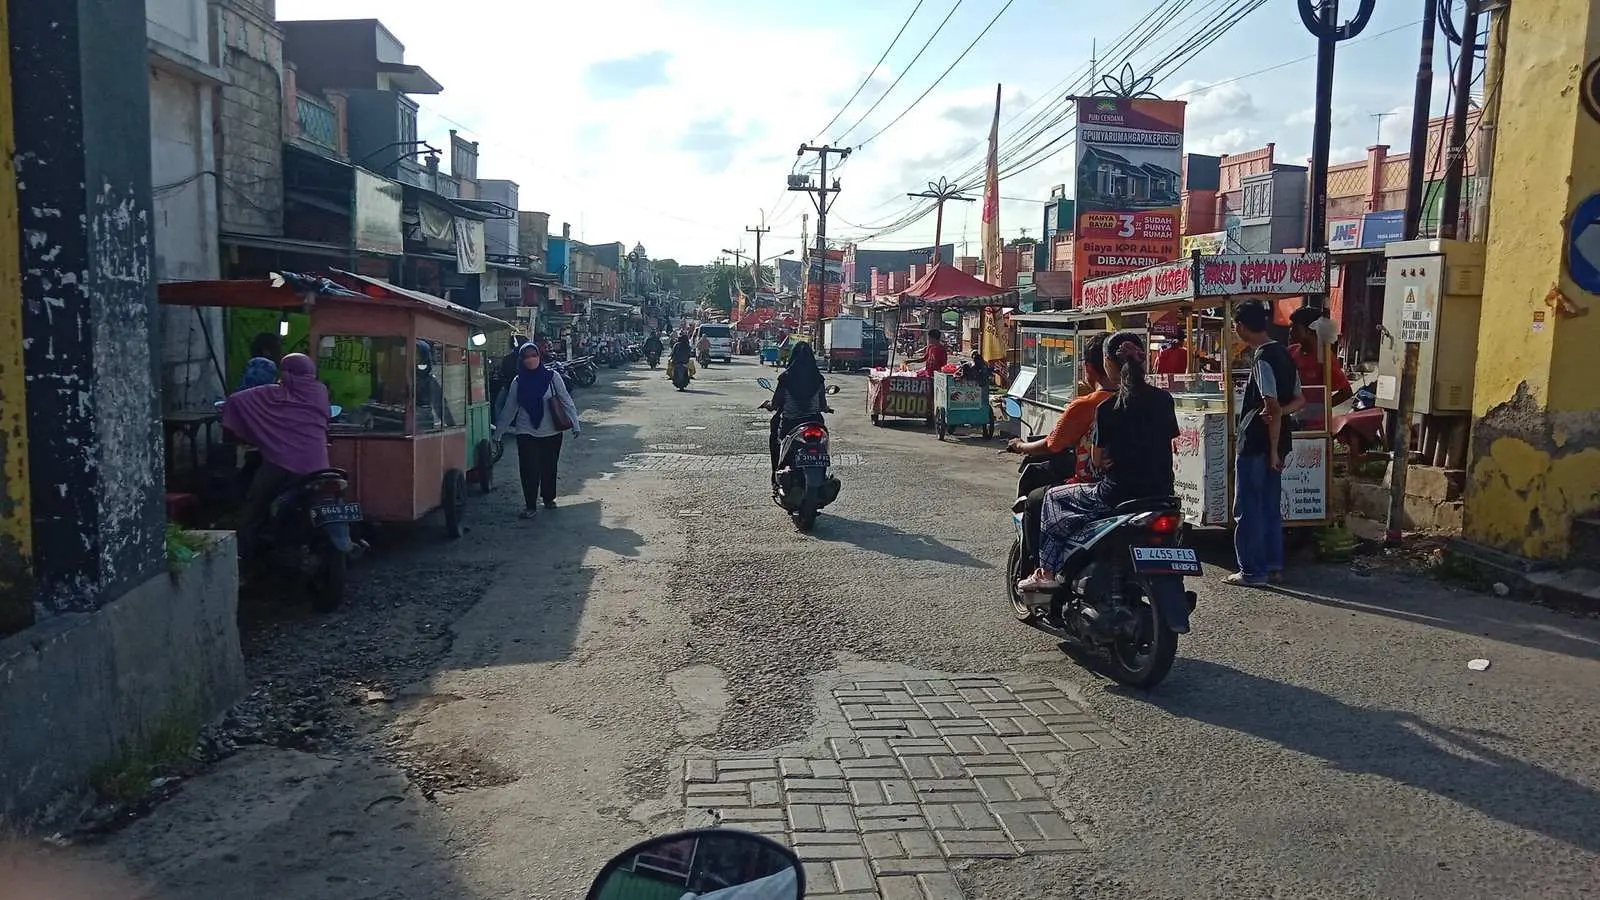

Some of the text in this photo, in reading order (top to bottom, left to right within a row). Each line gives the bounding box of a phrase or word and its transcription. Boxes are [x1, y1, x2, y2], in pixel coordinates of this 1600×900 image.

[1100, 114, 1124, 122] CENDANA
[1117, 214, 1136, 238] 3
[1144, 216, 1172, 224] SUDAH
[1144, 223, 1172, 232] PUNYA
[1331, 223, 1357, 242] JNE
[1143, 230, 1173, 239] RUMAH
[1083, 242, 1112, 253] Biaya
[1115, 243, 1137, 253] KPR
[1140, 244, 1159, 254] ALL
[1160, 245, 1173, 255] IN
[1097, 256, 1159, 266] DIBAYARIN!
[1111, 276, 1152, 305] SEAFOOD
[1155, 268, 1190, 296] KOREA
[889, 378, 928, 393] SERBA
[886, 391, 928, 414] 2000
[1136, 549, 1142, 559] B
[1149, 549, 1173, 560] 4455
